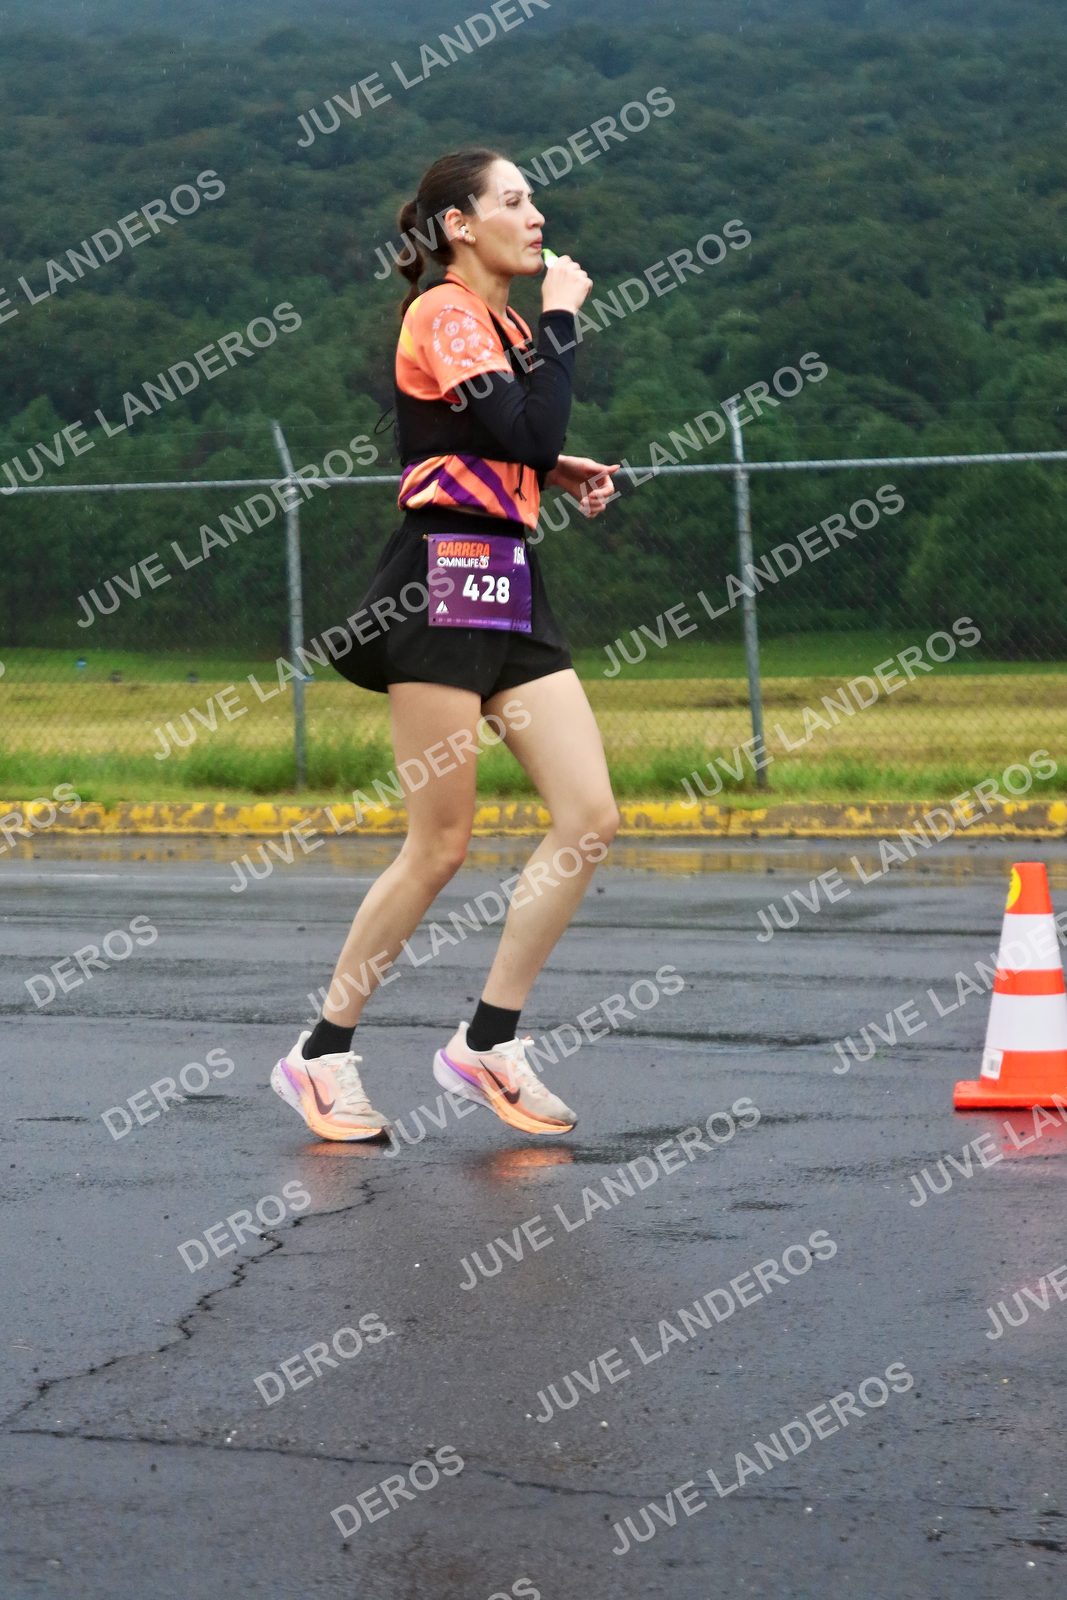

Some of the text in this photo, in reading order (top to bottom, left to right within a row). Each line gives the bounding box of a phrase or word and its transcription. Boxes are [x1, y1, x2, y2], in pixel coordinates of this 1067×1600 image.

[437, 541, 490, 557] CARRERA
[437, 556, 479, 568] OMNILIFE
[462, 574, 510, 604] 428
